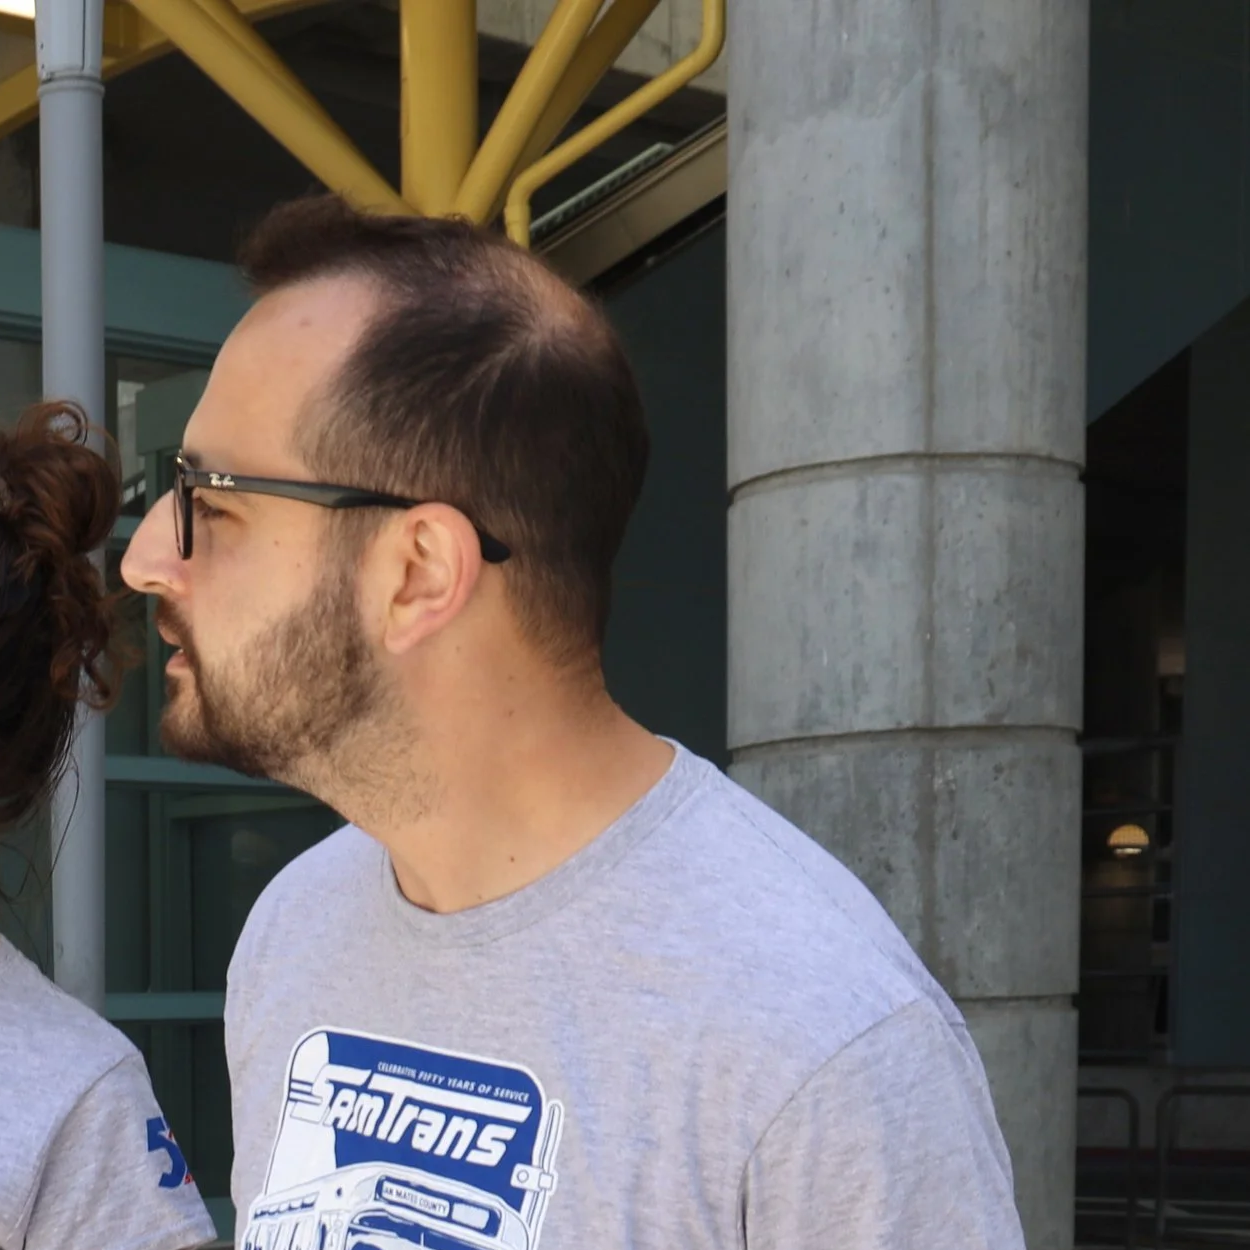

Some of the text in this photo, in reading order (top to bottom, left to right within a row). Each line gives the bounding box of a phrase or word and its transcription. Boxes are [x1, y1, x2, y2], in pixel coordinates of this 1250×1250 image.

[417, 1070, 445, 1084] FIFTY
[447, 1076, 475, 1092] YEARS
[477, 1082, 492, 1094] OF
[494, 1086, 530, 1104] SERVICE
[395, 1188, 447, 1213] MATEO COUNTY
